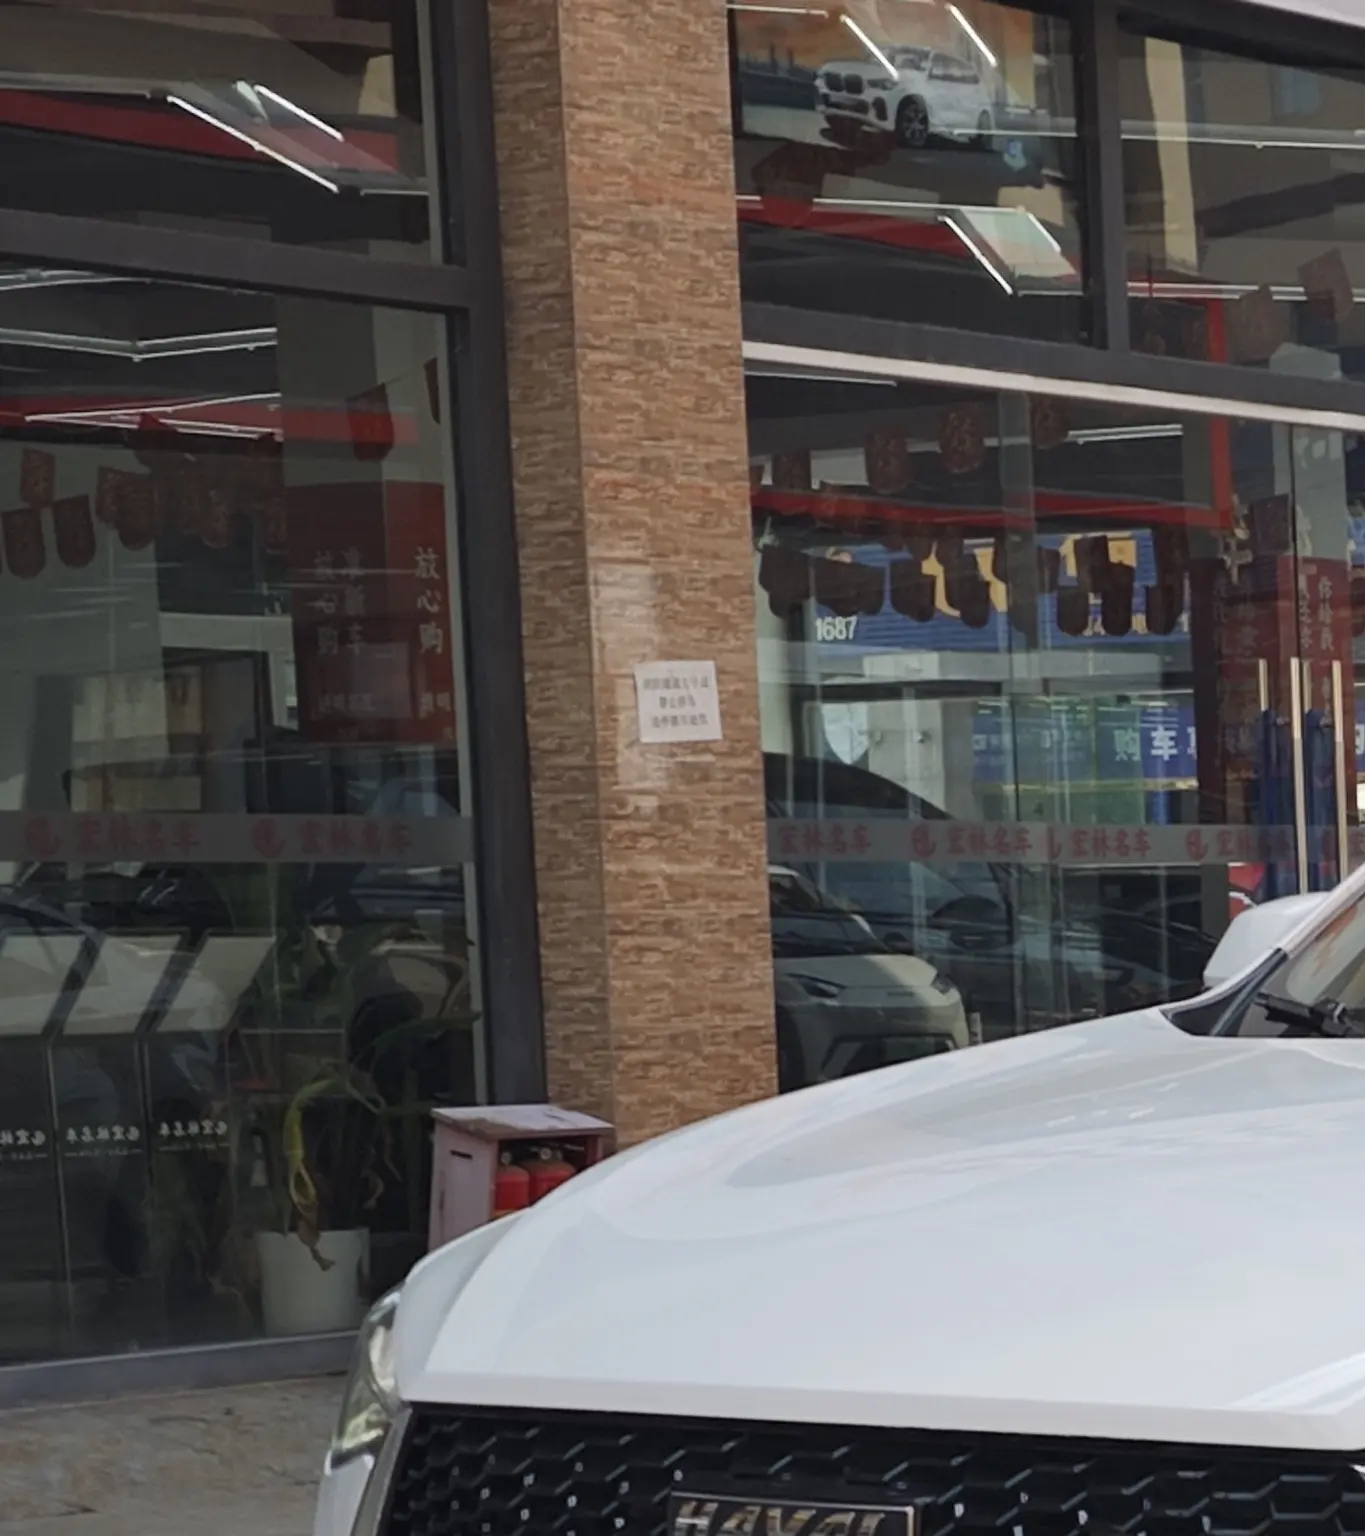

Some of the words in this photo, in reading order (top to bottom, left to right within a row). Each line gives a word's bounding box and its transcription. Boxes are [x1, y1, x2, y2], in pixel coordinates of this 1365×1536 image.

[415, 546, 444, 655] 放心购
[815, 616, 858, 642] 1687
